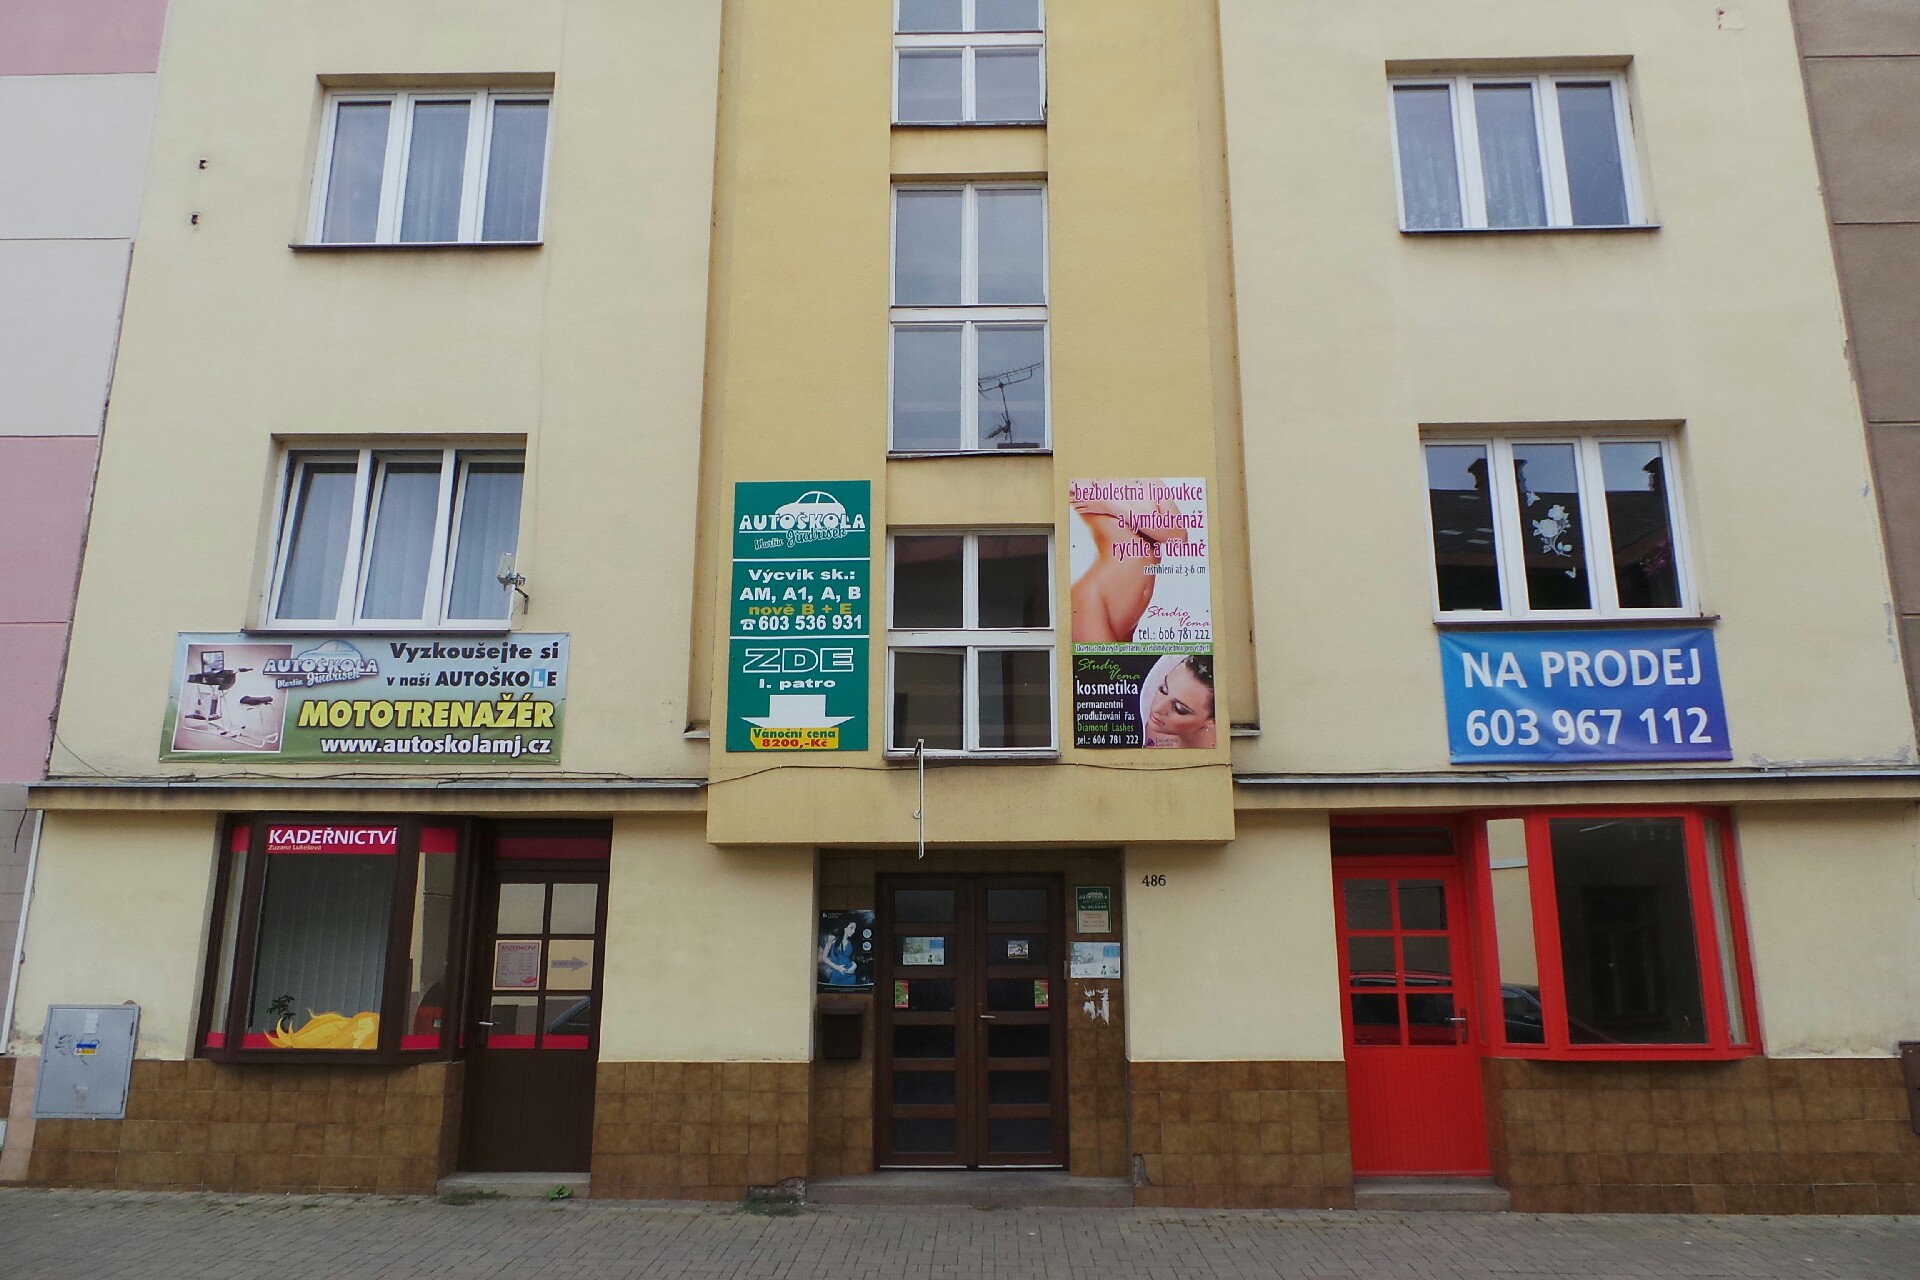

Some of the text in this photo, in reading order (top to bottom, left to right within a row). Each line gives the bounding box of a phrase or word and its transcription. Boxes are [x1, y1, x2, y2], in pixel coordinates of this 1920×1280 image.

[1074, 482, 1203, 504] bezbolestná liposukce
[739, 512, 866, 530] AUTOŠKOLA
[1118, 510, 1204, 533] a lymfodrenáž
[1112, 538, 1206, 561] rychle a účinně
[748, 569, 856, 583] Výcvik sk.:
[1197, 566, 1206, 574] cm
[740, 586, 862, 603] AM, A1, A, B
[748, 603, 852, 616] nově B + E
[1148, 606, 1189, 618] Studio
[758, 614, 862, 631] 603 536 931
[1138, 627, 1211, 643] tel.: 606 781 222
[390, 642, 559, 664] Vyzkoušejte si
[743, 647, 854, 673] ZDE
[264, 657, 379, 673] AUTOŠKOLA
[1077, 658, 1121, 672] Studio
[1462, 648, 1702, 689] NA PRODEJ
[387, 666, 558, 689] v naší AUTOŠKOLE
[780, 678, 836, 690] patro
[1076, 680, 1139, 695] kosmetika
[297, 693, 555, 728] MOTOTRENAŽÉR
[1076, 699, 1124, 711] permanentní
[1076, 710, 1135, 722] prodlužování řas
[753, 728, 836, 739] Vánoční cena
[1077, 723, 1134, 732] Diamond Lashes
[1466, 707, 1713, 747] 603 967 112
[320, 733, 552, 758] www.autoskolamj.cz
[1092, 735, 1106, 744] 606
[1109, 735, 1122, 744] 781
[1125, 735, 1139, 744] 222
[268, 827, 398, 845] KADEŘNICTVÍ
[1141, 874, 1167, 887] 486
